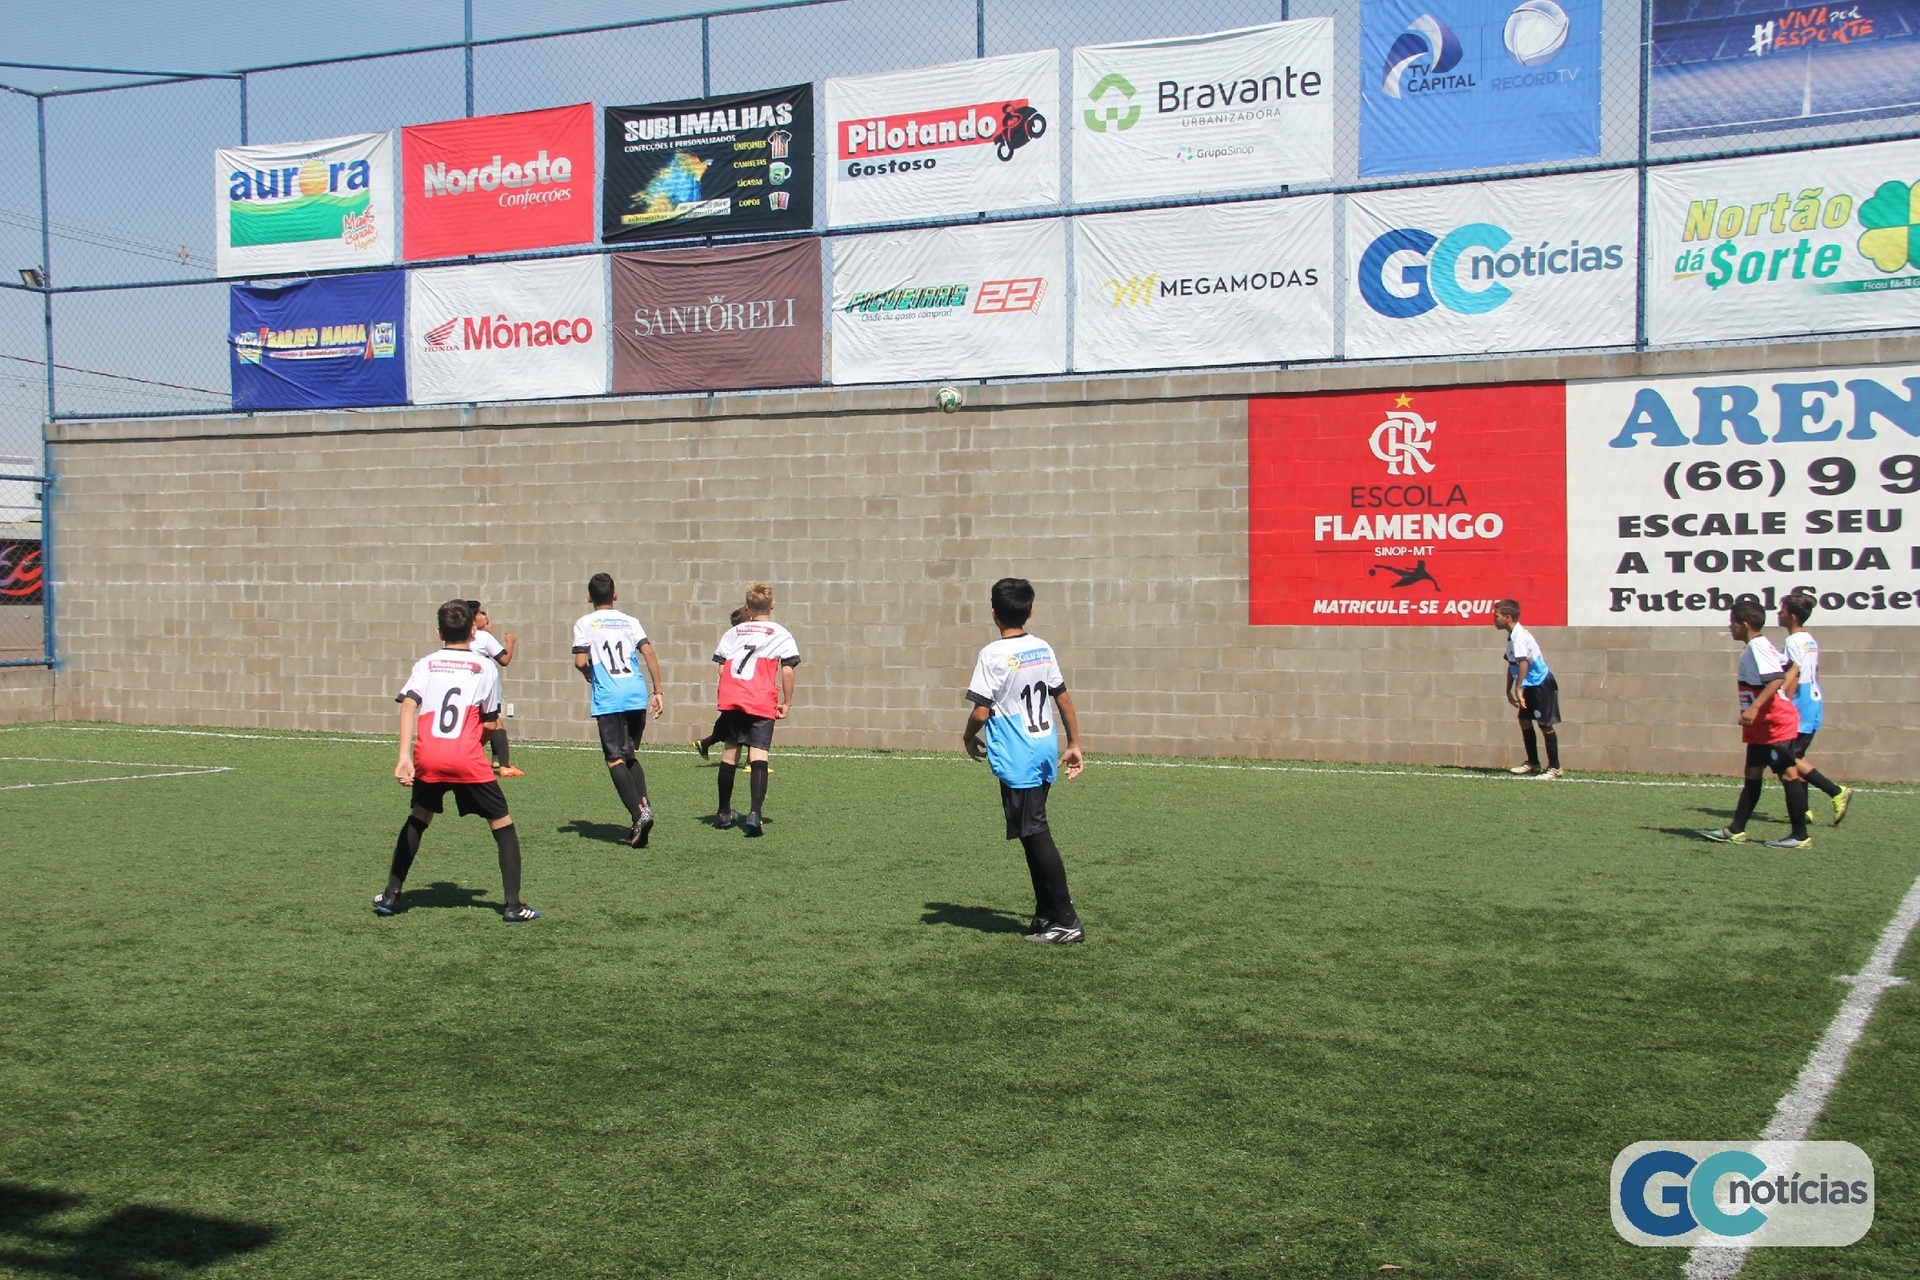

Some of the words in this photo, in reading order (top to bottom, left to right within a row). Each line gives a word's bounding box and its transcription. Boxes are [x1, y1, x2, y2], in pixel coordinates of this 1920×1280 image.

[1774, 18, 1874, 48] ESPORTE
[1407, 74, 1476, 92] CAPITAL
[1408, 64, 1430, 77] TV
[1158, 66, 1321, 114] Bravante
[624, 103, 792, 142] SUBLIMALHAS
[848, 109, 997, 155] Pilotando
[1182, 108, 1282, 128] URBANIZADORA
[624, 141, 669, 153] CONFECÇÕES
[675, 135, 736, 148] PERSONALIZADOS
[733, 159, 767, 169] CAMISETAS
[847, 158, 937, 178] Gostoso
[230, 159, 370, 201] aurora
[499, 187, 572, 209] Confecções
[739, 199, 760, 207] COPOS
[1681, 187, 1853, 243] Nortão
[1471, 240, 1624, 280] notícias
[1675, 248, 1706, 273] dá
[977, 278, 1040, 314] 22
[1160, 268, 1319, 298] MEGAMODAS
[861, 313, 882, 322] Onde
[895, 312, 916, 321] gosto
[464, 314, 593, 350] Mônaco
[424, 345, 460, 353] HONDA
[1664, 458, 1786, 499] (66)
[1350, 484, 1468, 508] ESCOLA
[1314, 513, 1503, 541] FLAMENGO
[1618, 511, 1786, 538] ESCALE
[1805, 508, 1902, 534] SEU
[1374, 546, 1435, 557] SINOP-MT
[1615, 552, 1649, 574] A
[1665, 547, 1890, 573] TORCIDA
[1313, 599, 1438, 615] MATRICULE-SE
[430, 660, 473, 670] Pilotando
[602, 640, 632, 675] 11
[736, 645, 757, 675] 7
[439, 687, 461, 734] 6
[1021, 680, 1050, 733] 12
